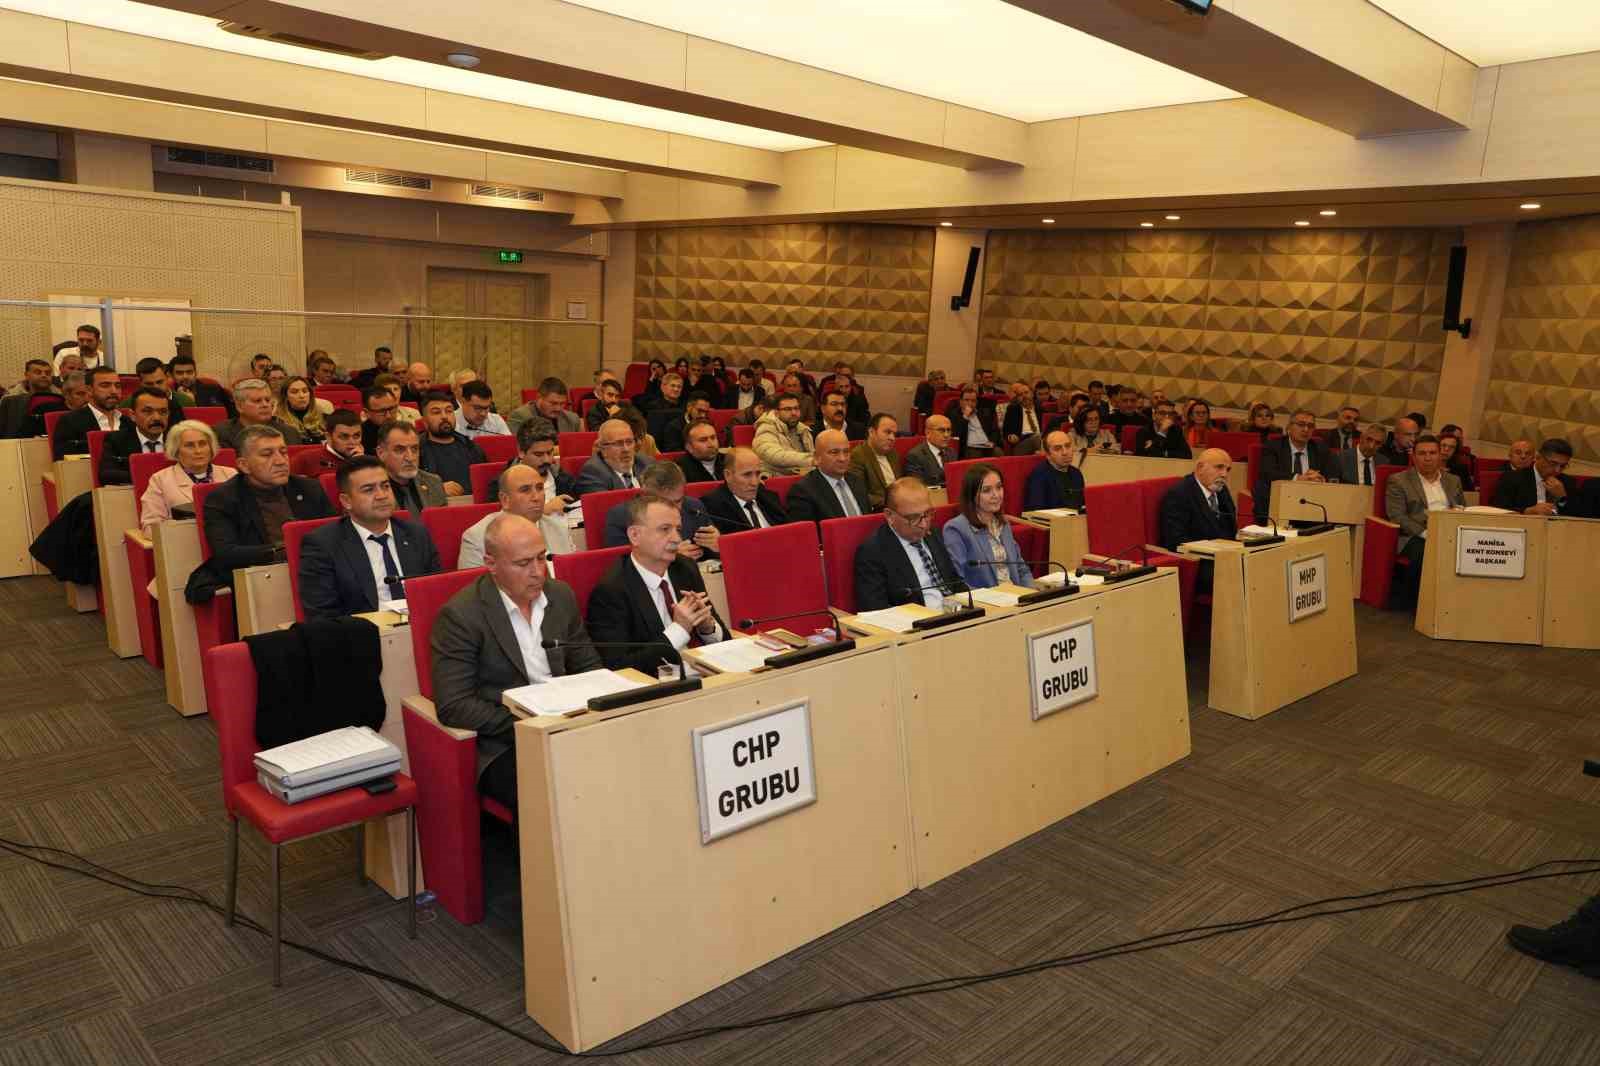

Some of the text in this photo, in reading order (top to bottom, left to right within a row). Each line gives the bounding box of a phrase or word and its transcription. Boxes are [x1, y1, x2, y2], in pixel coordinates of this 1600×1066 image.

[1299, 567, 1317, 585] MHP
[1296, 590, 1322, 611] GRUBU
[1050, 638, 1077, 663] CHP
[1042, 666, 1088, 699] GRUBU
[732, 730, 781, 767] CHP
[718, 766, 800, 817] GRUBU
